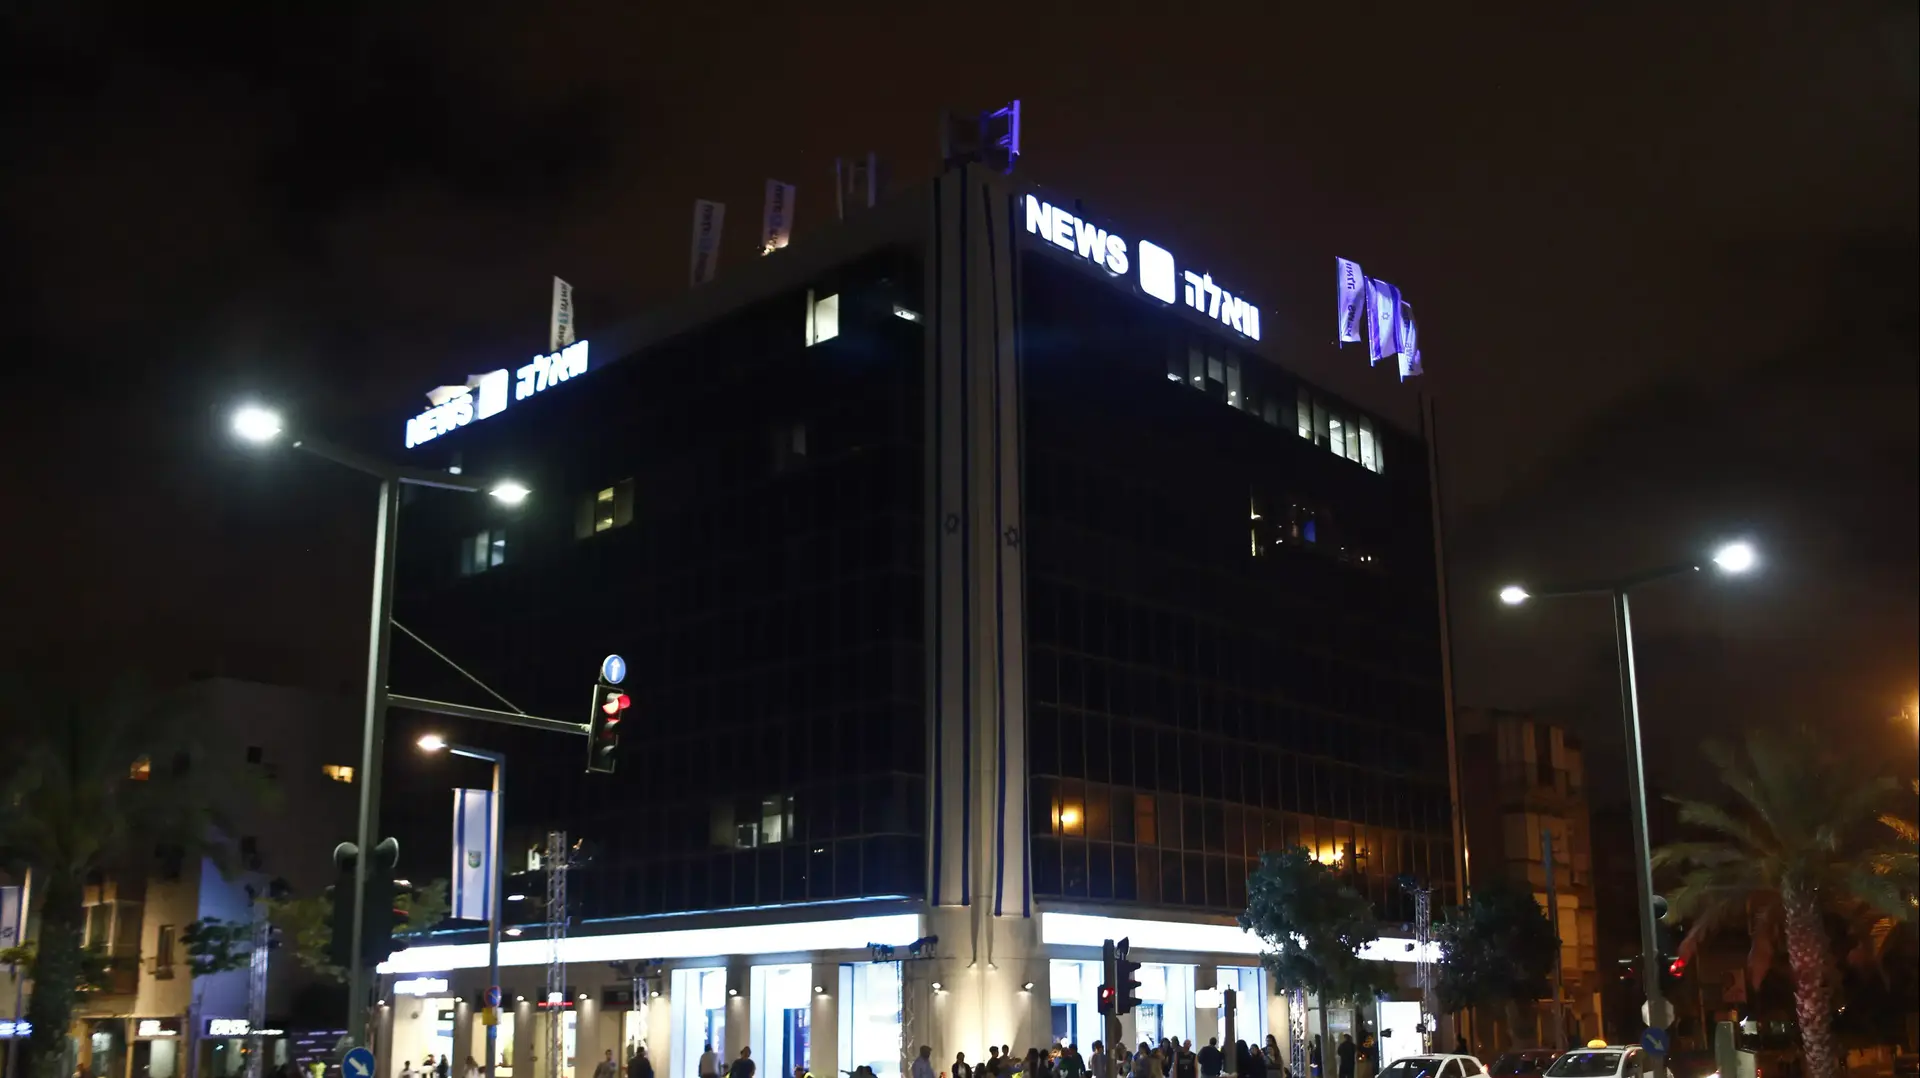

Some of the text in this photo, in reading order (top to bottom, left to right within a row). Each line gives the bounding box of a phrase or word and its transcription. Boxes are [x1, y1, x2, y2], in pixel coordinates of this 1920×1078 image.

[1025, 194, 1261, 342] NEWS וואלה
[405, 340, 589, 449] NEWS וואלה
